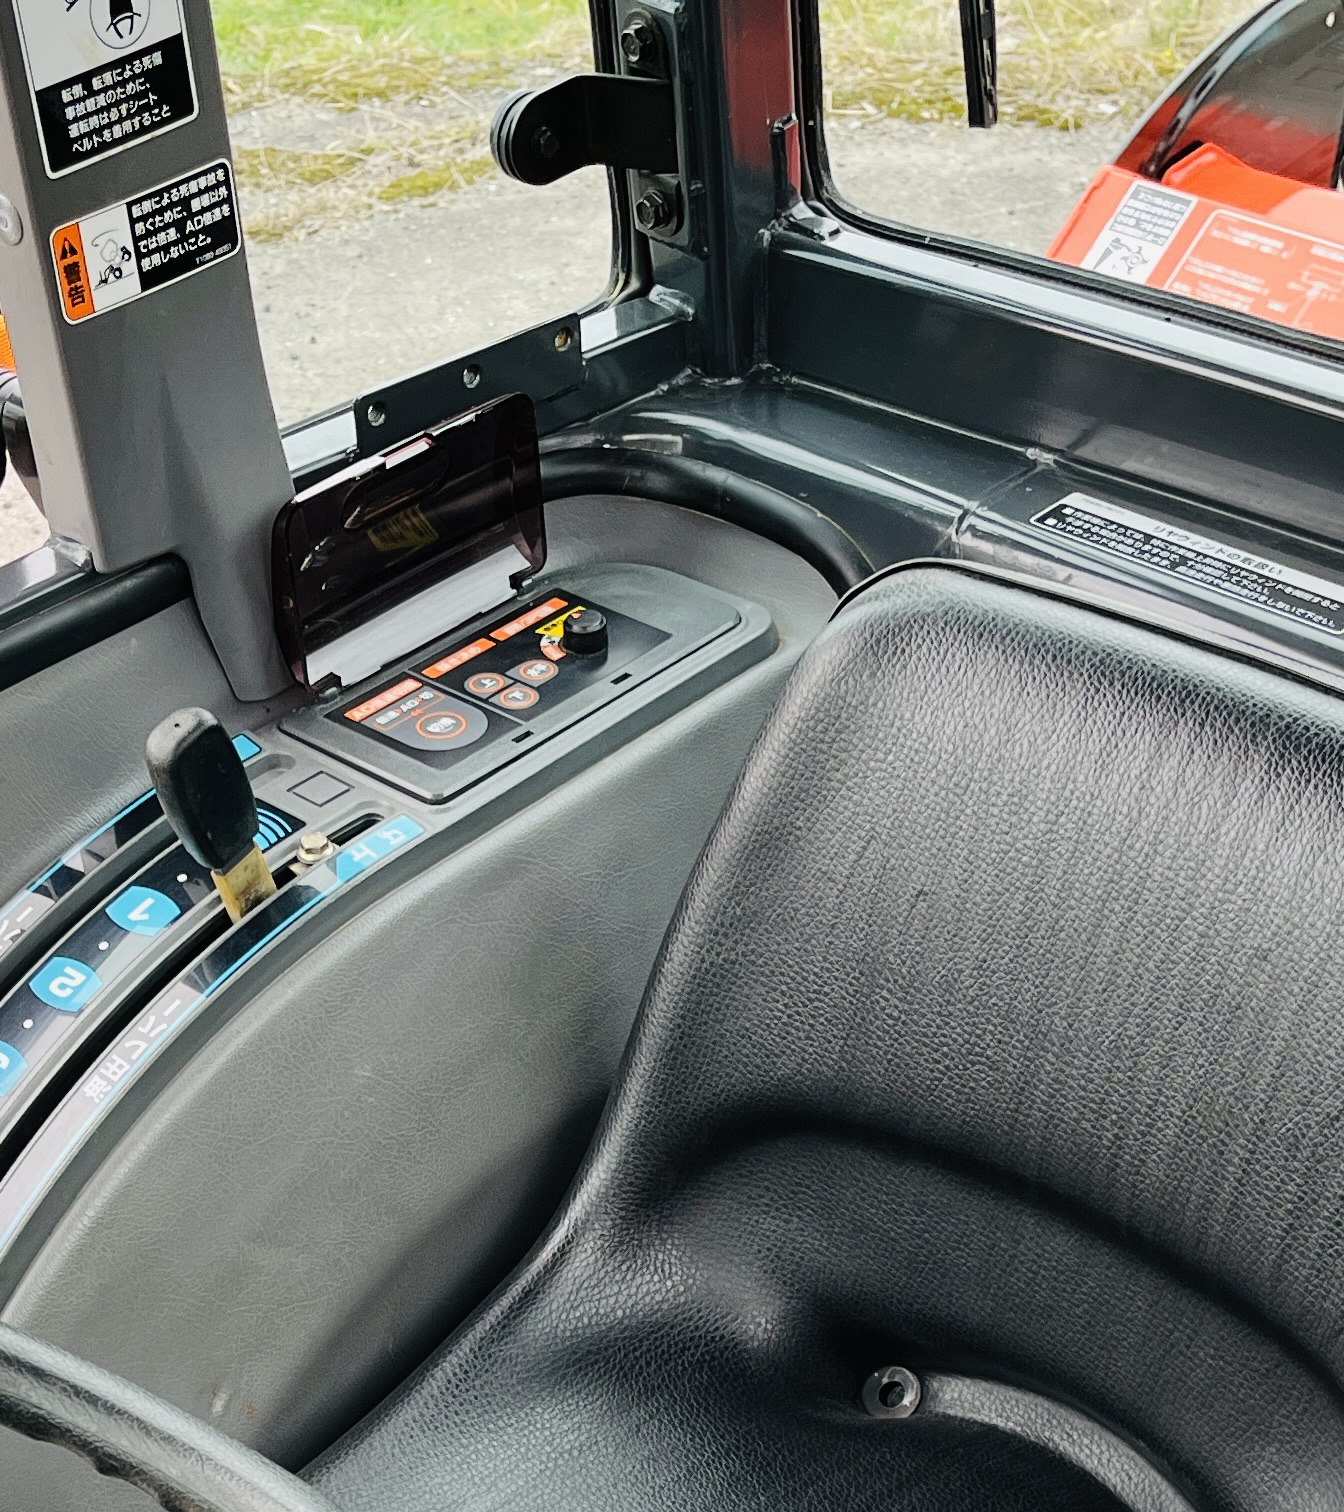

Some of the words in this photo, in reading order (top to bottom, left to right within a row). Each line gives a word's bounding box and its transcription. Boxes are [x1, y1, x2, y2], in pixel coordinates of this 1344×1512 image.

[61, 260, 88, 307] 警告
[480, 676, 497, 689] 上
[349, 826, 408, 864] 上げ
[128, 897, 156, 921] 1
[48, 967, 88, 996] 2
[81, 996, 183, 1103] 油圧レバー
